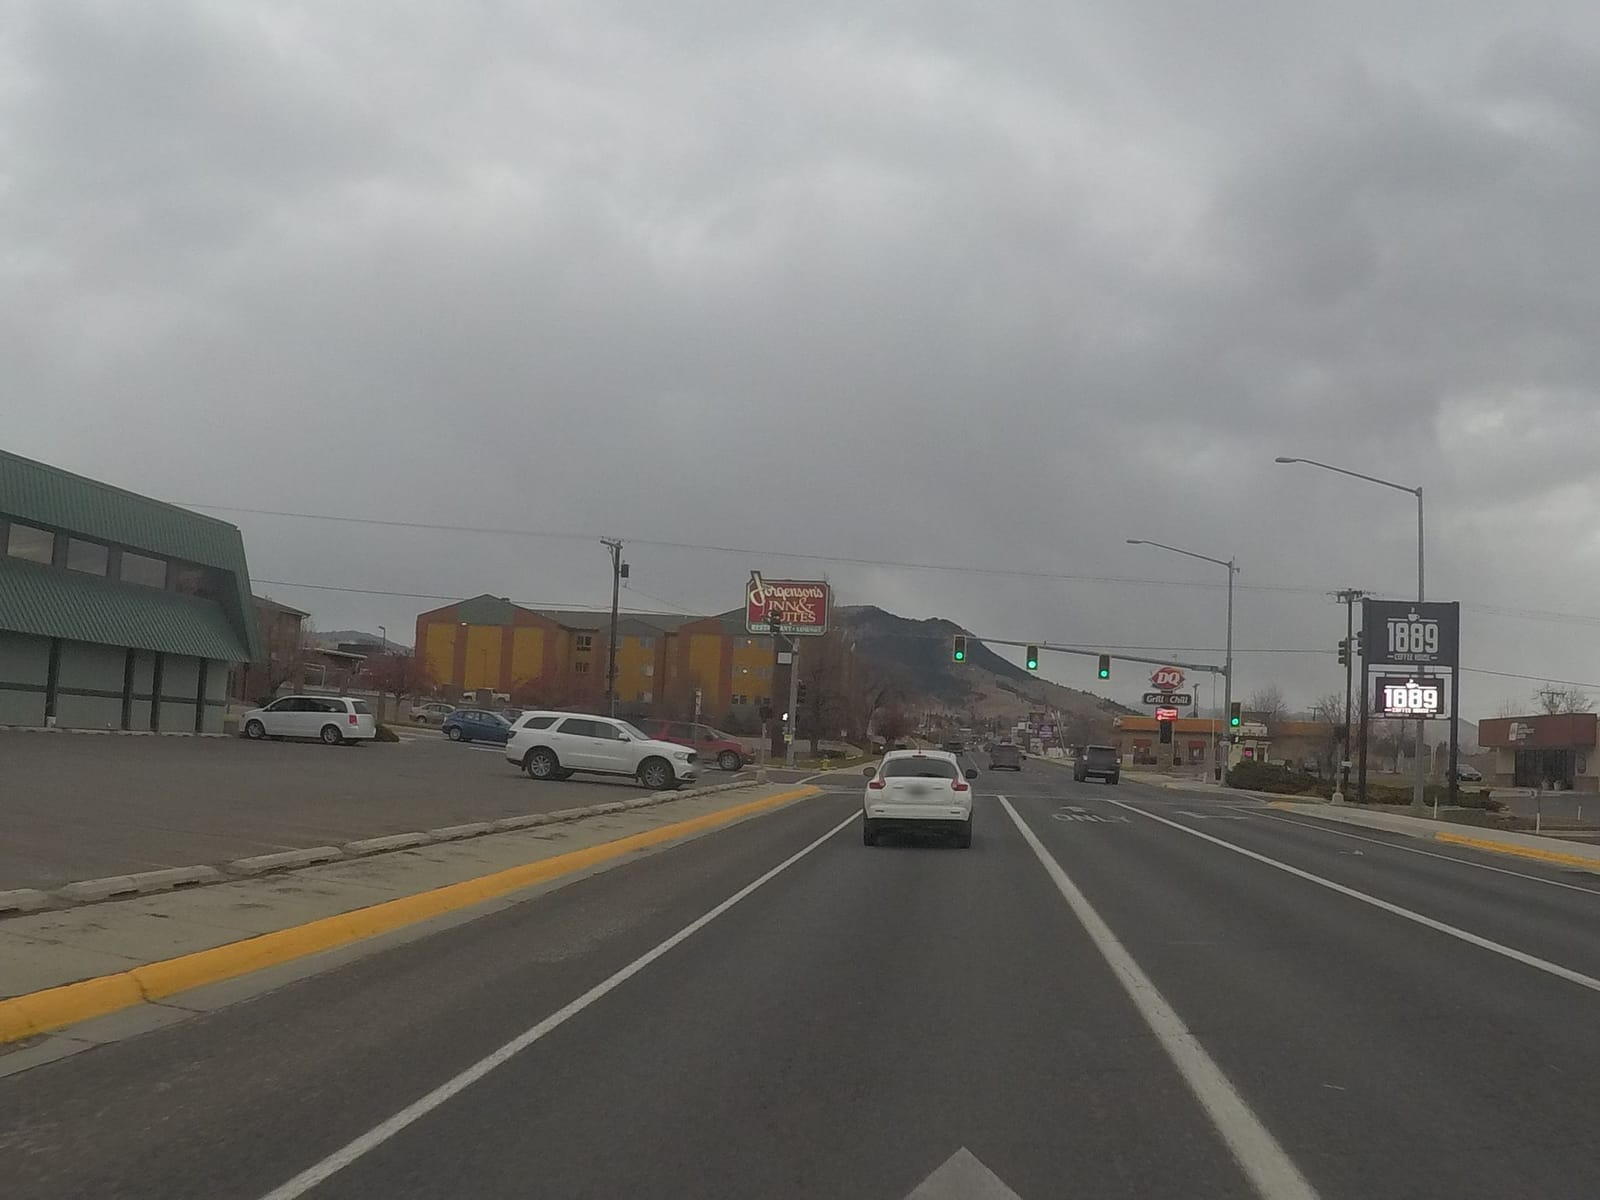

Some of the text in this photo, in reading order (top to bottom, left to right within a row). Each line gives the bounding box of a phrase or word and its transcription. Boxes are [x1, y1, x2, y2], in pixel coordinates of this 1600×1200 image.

[750, 573, 824, 607] Jorgenson's
[768, 597, 815, 614] INN &
[1387, 622, 1439, 654] 1889
[1157, 672, 1181, 686] DQ
[1146, 695, 1188, 704] Grill Chill
[1384, 688, 1438, 709] 1889
